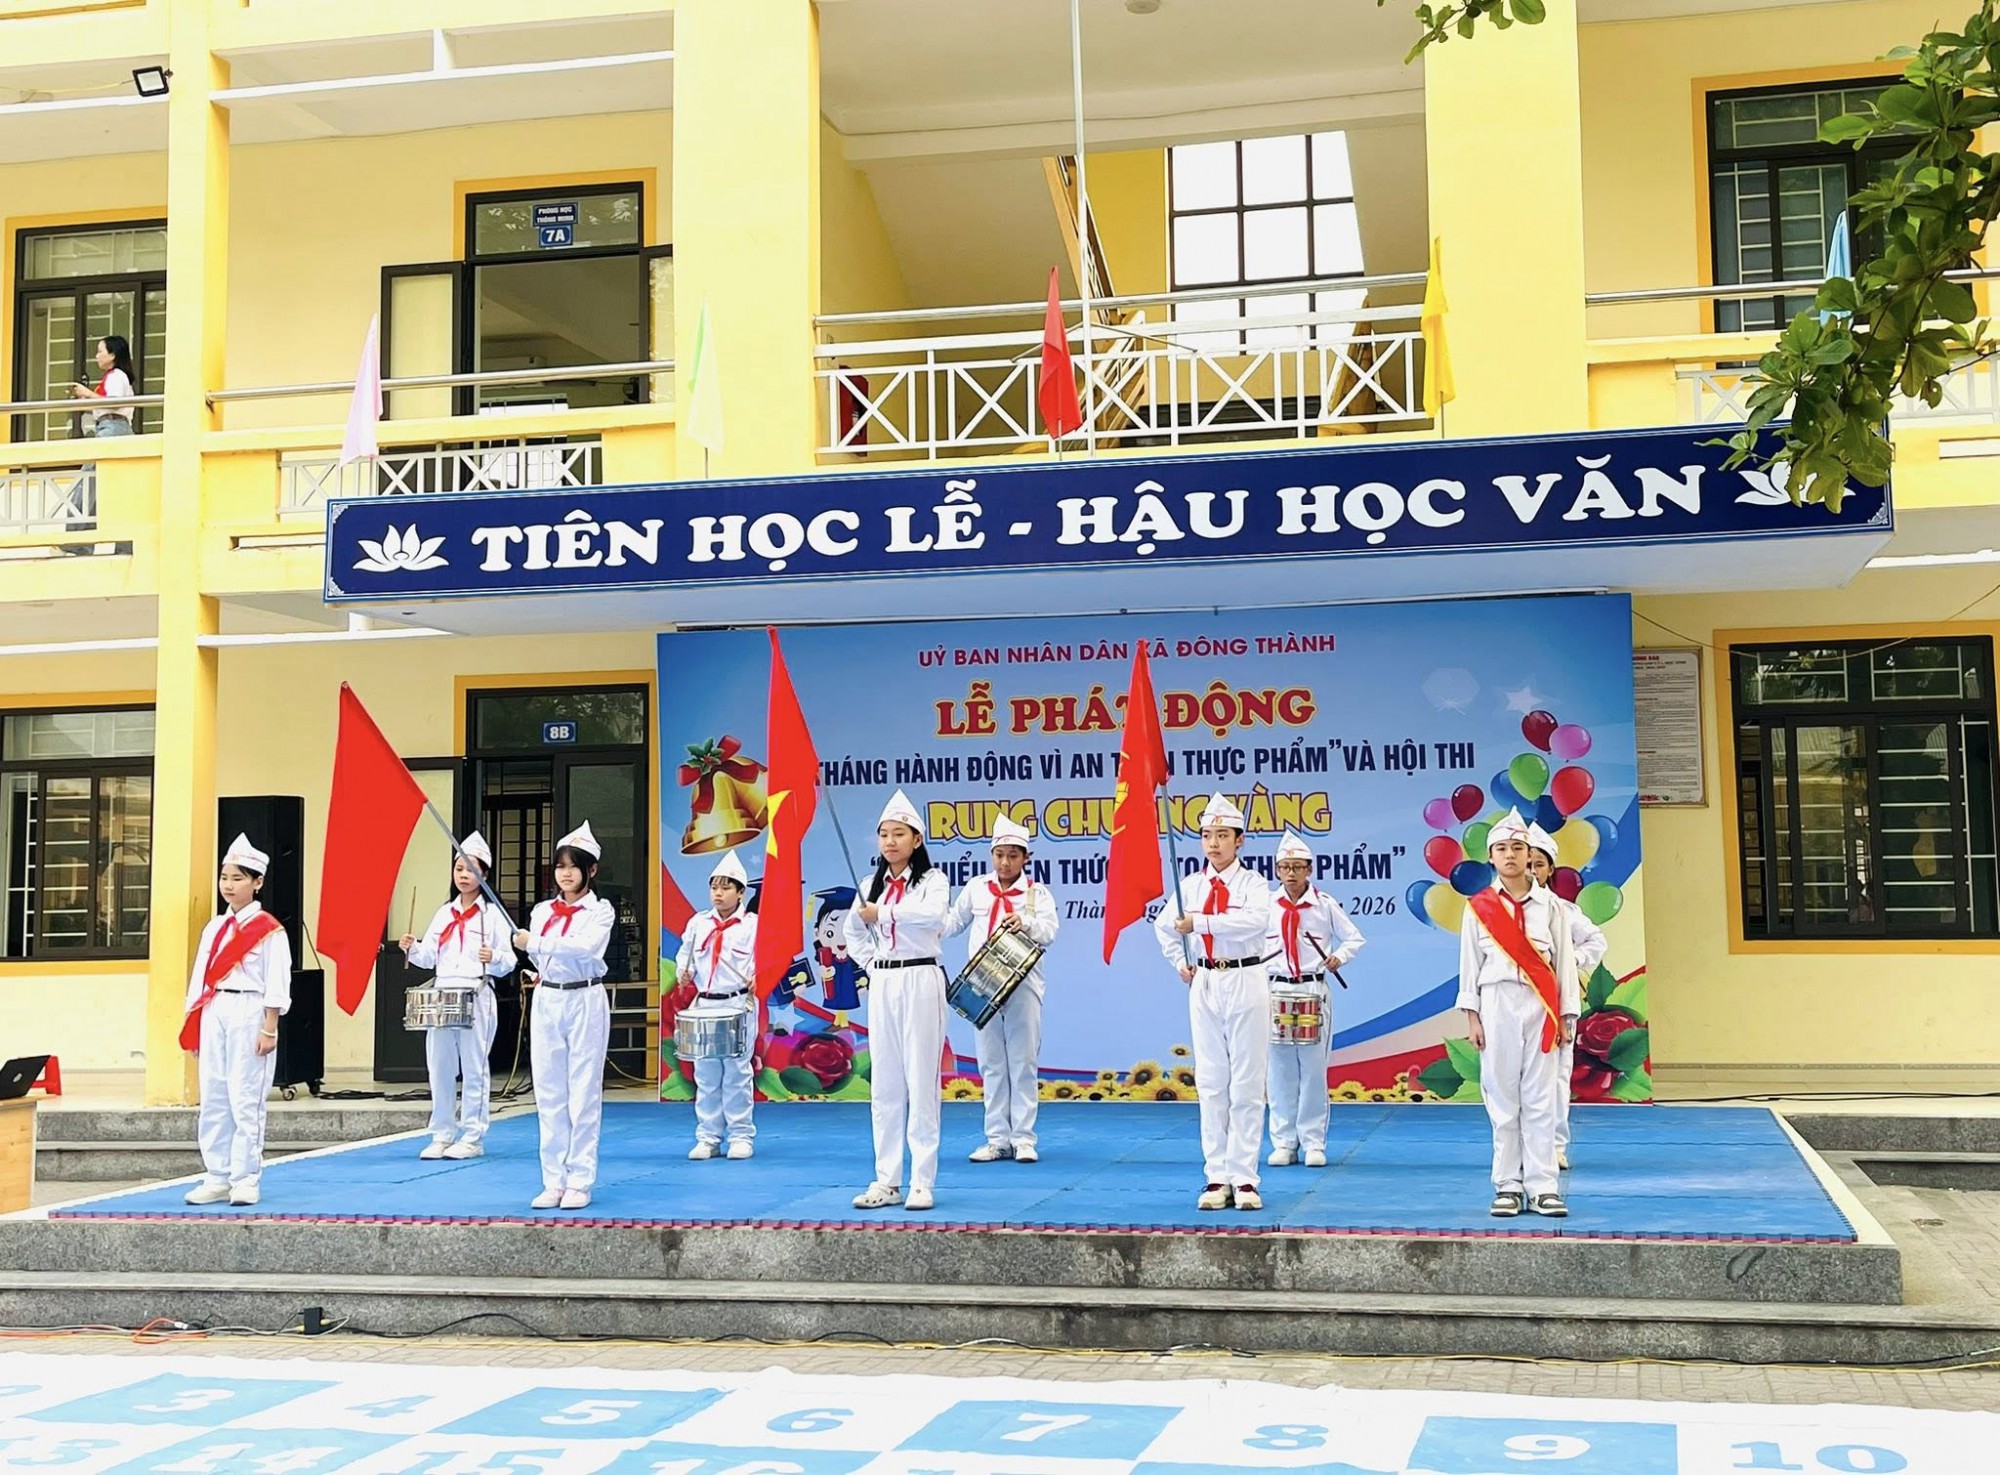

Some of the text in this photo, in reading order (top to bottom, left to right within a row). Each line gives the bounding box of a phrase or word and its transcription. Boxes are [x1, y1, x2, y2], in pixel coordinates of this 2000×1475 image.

[545, 229, 566, 242] 7A
[472, 509, 665, 573] TIÊN
[688, 509, 861, 573] HỌC
[885, 477, 986, 554] LỄ
[1055, 478, 1247, 556] HẬU
[1276, 478, 1466, 546] HỌC
[1491, 453, 1707, 523] VĂN
[919, 644, 946, 666] UỶ
[954, 647, 999, 665] BAN
[1007, 641, 1071, 663] NHÂN
[1080, 639, 1128, 661] DÂN
[1176, 635, 1248, 657] ĐÔNG
[1255, 631, 1335, 654] THÀNH
[935, 680, 997, 736] LỄ
[1163, 679, 1318, 739] ĐỘNG
[549, 725, 570, 739] 8B
[895, 753, 960, 784] HÀNH
[966, 750, 1033, 787] ĐỘNG
[1040, 749, 1062, 780] VÌ
[1070, 753, 1104, 779] AN
[1182, 746, 1246, 781] THỰC
[1343, 739, 1376, 772] VÀ
[1384, 738, 1427, 776] HỘI
[1434, 742, 1475, 770] THI
[1043, 794, 1211, 837] CHUNG
[1350, 896, 1397, 916] 2026
[132, 1388, 1909, 1474] 3 4 5 6 7 8 9 10
